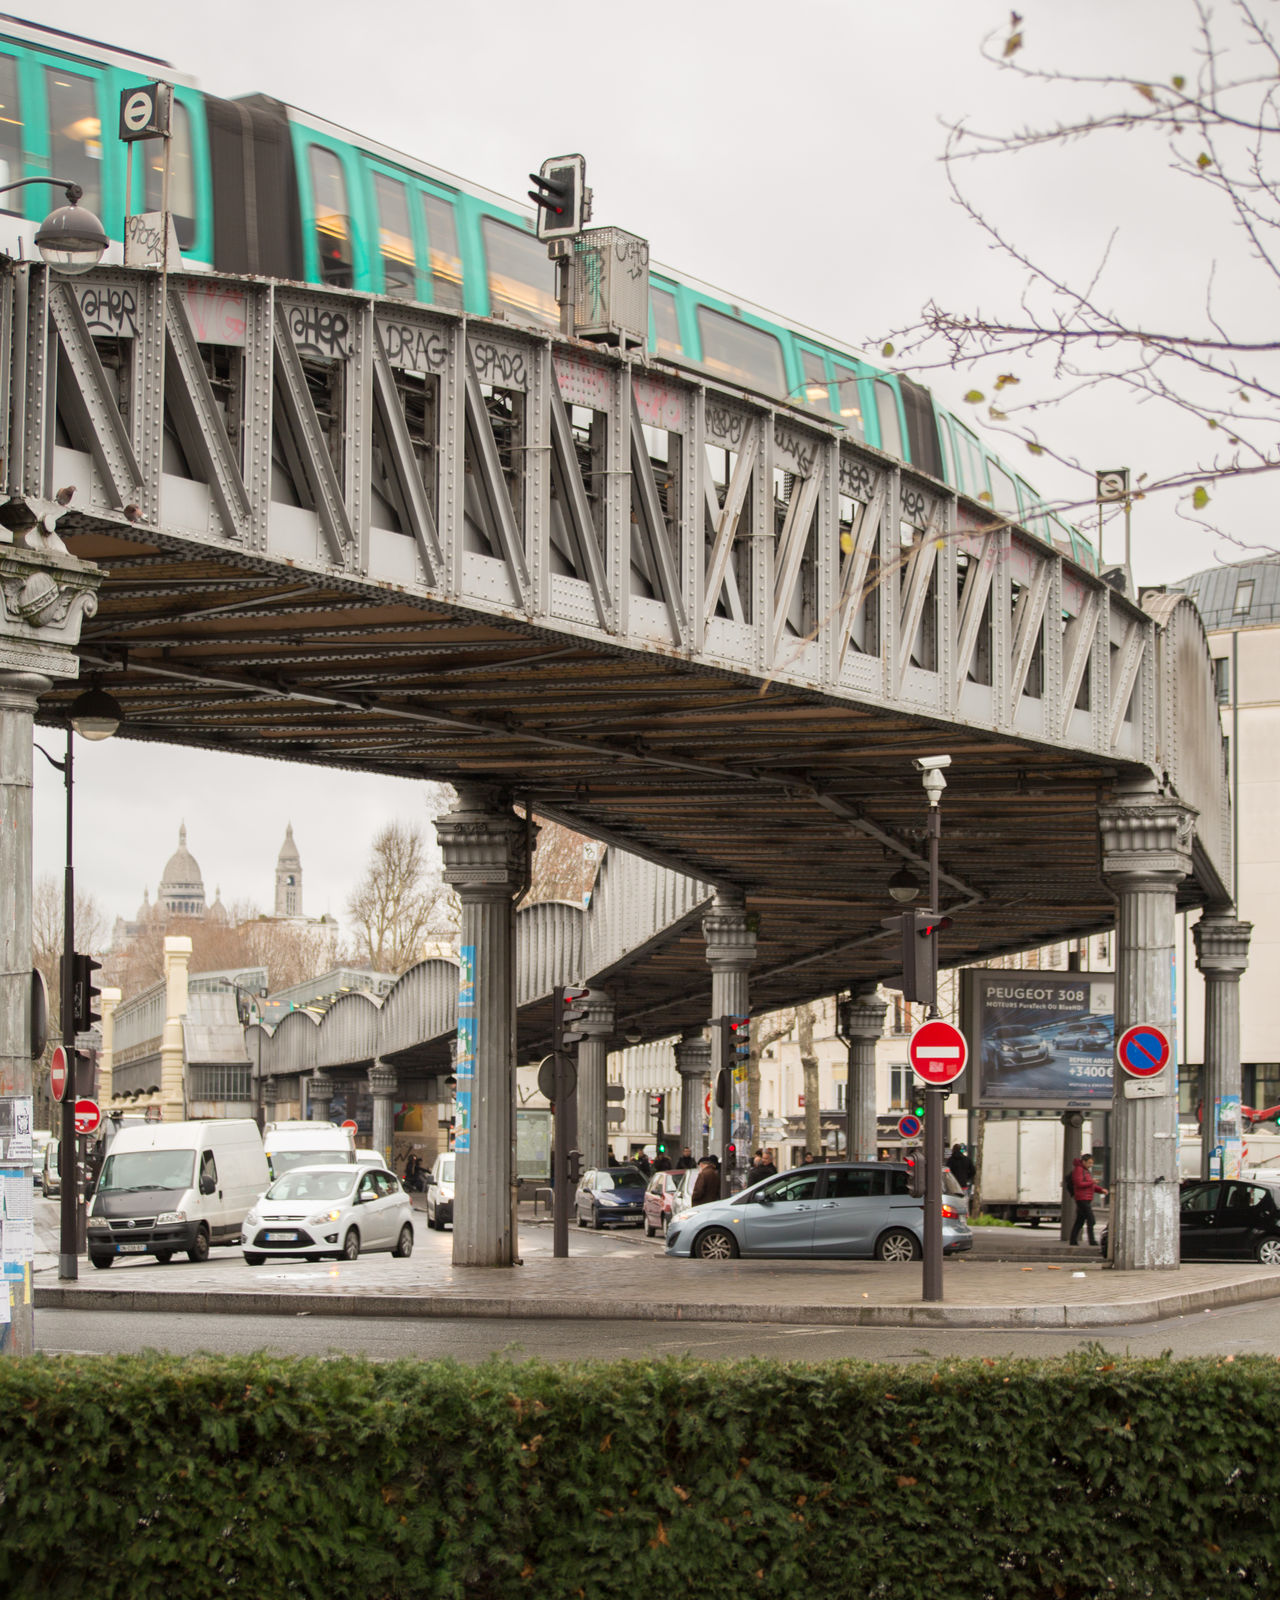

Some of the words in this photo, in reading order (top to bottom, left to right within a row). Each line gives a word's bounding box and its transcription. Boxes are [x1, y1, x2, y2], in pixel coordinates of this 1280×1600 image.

[386, 325, 448, 371] DRAG
[986, 987, 1054, 1000] PEUGEOT
[1058, 990, 1084, 1001] 308
